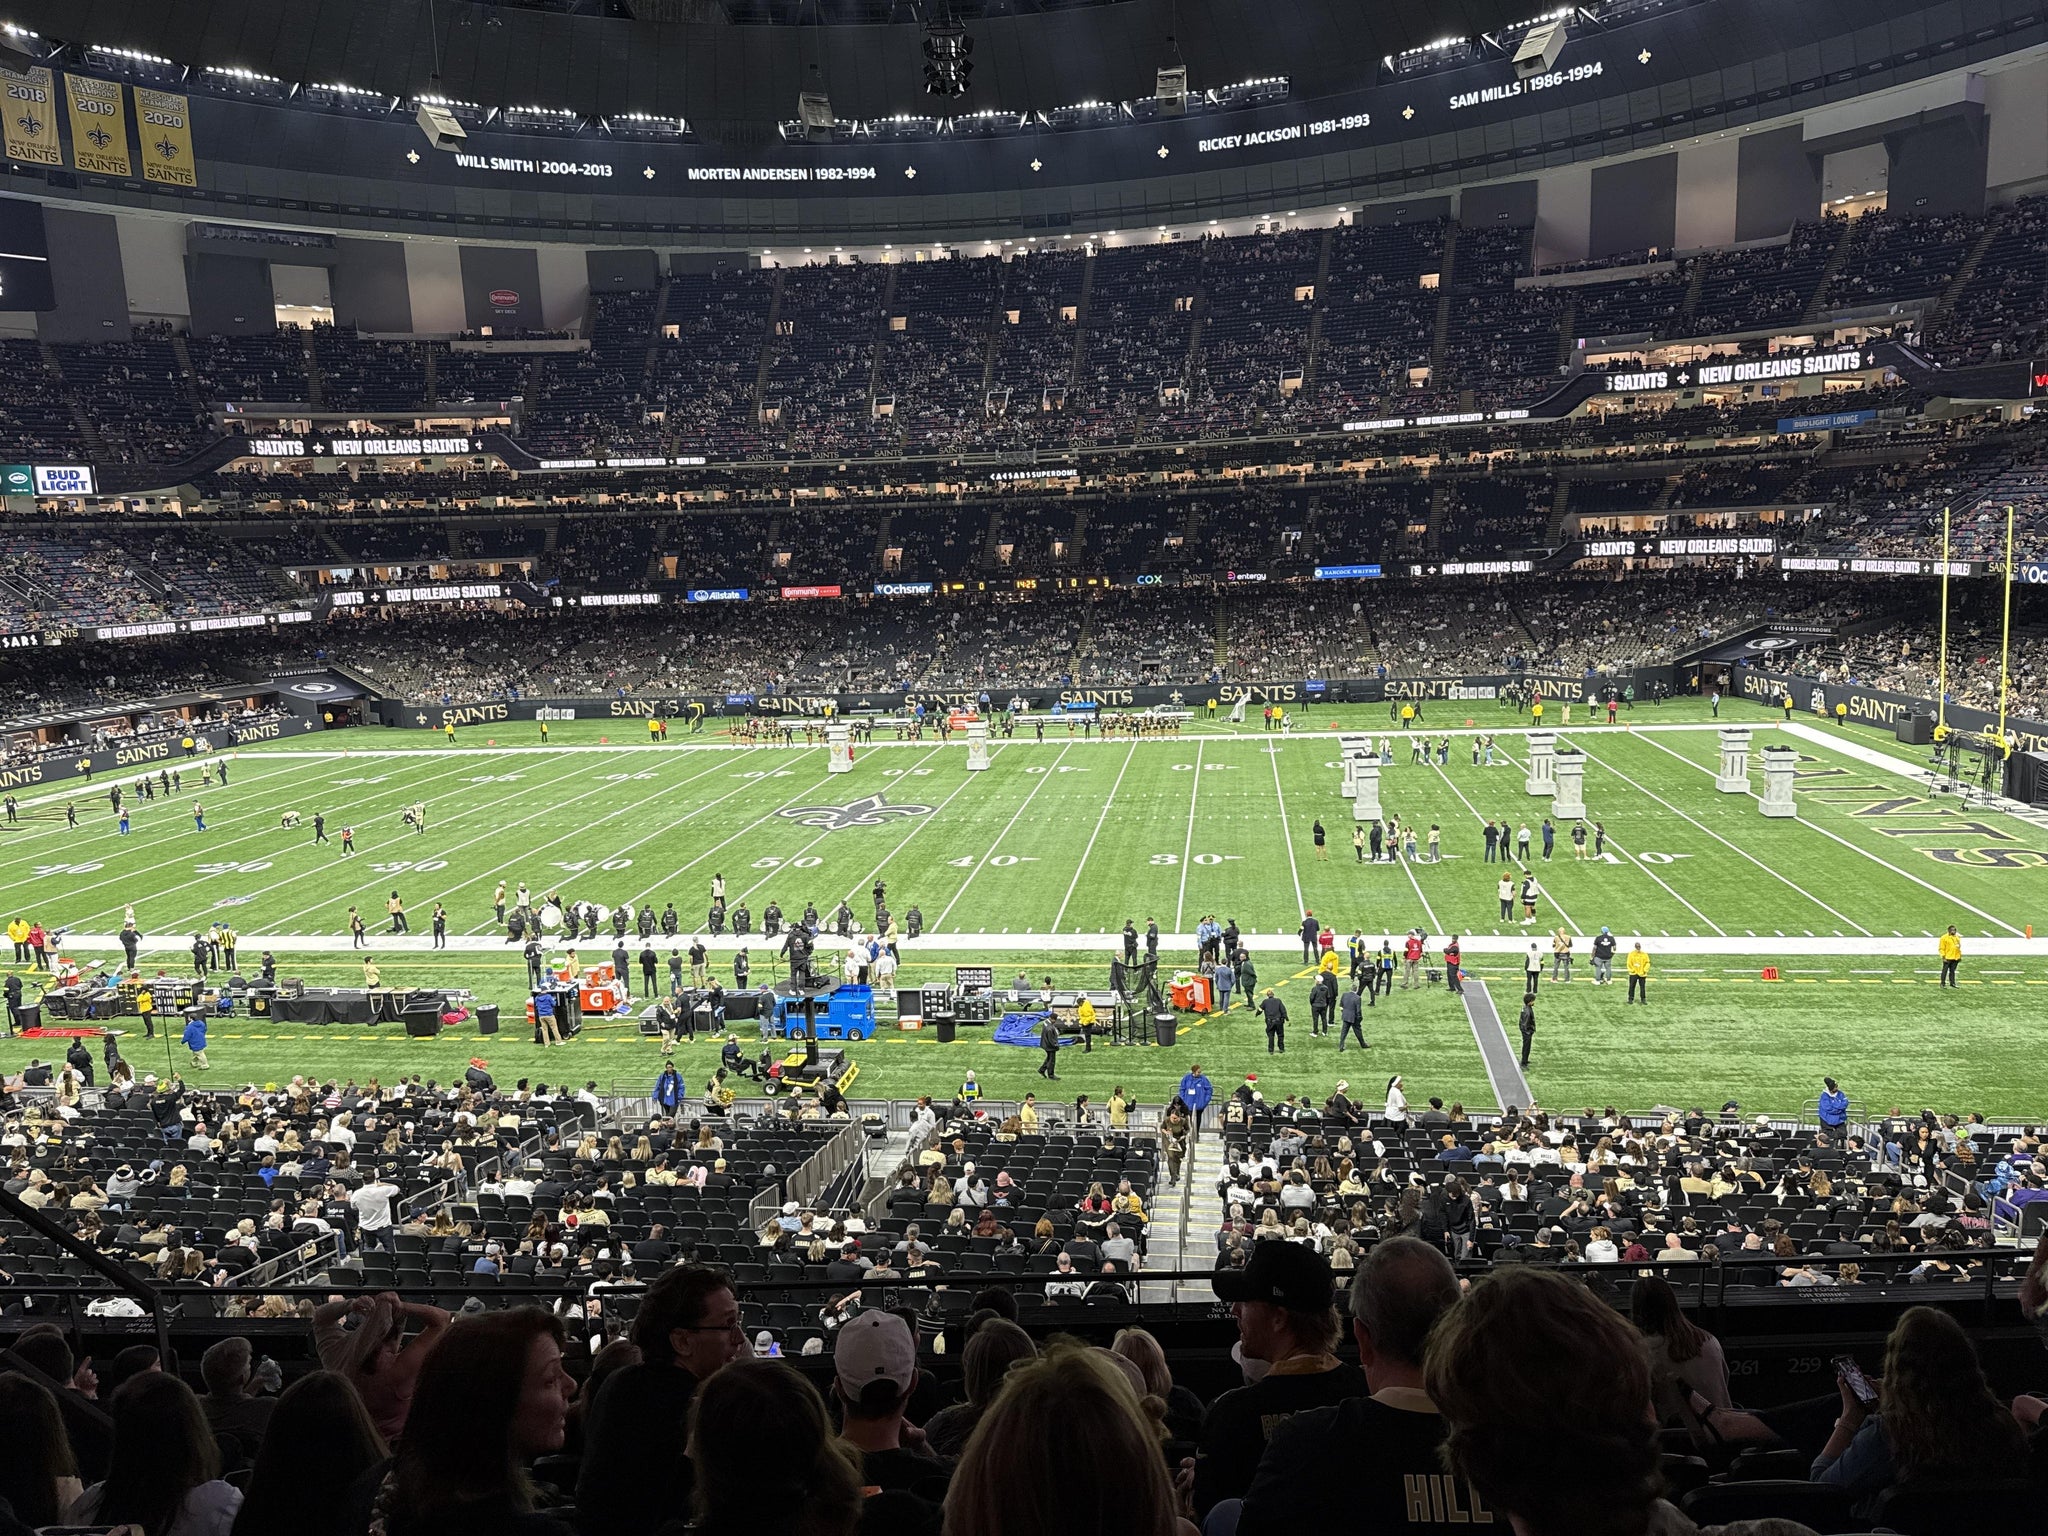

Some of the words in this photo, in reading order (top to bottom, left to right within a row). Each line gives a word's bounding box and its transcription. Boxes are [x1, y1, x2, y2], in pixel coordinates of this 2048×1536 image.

[7, 84, 47, 103] 2018
[1449, 90, 1480, 110] SAM
[1481, 81, 1522, 103] MILLS
[76, 98, 116, 117] 2019
[139, 97, 185, 113] CHAMPIONS
[144, 110, 184, 129] 2020
[1198, 135, 1242, 153] RICKEY
[1243, 126, 1301, 147] JACKSON
[9, 146, 59, 163] SAINTS
[78, 158, 127, 174] SAINTS
[455, 154, 489, 169] WILL
[490, 158, 534, 172] SMITH
[146, 169, 193, 185] SAINTS
[688, 168, 741, 181] MORTEN
[742, 168, 808, 181] ANDERSEN
[1699, 364, 1733, 385] NEW
[1735, 358, 1801, 381] ORLEANS
[1804, 352, 1861, 374] SAINTS
[1614, 371, 1668, 390] SAINTS
[1808, 418, 1830, 428] LIGHT
[1832, 414, 1859, 424] LOUNGE
[1267, 427, 1298, 435] SAINTS
[1633, 430, 1666, 440] SAINTS
[1706, 424, 1740, 434] SAINTS
[1134, 436, 1163, 444] SAINTS
[1199, 431, 1230, 440] SAINTS
[1561, 436, 1594, 445] SAINTS
[256, 440, 304, 456] SAINTS
[332, 439, 362, 455] NEW
[364, 438, 421, 454] ORLEANS
[423, 438, 469, 453] SAINTS
[938, 446, 968, 454] SAINTS
[1068, 440, 1098, 448] SAINTS
[1490, 441, 1522, 450] SAINTS
[810, 452, 840, 460] SAINTS
[874, 449, 904, 458] SAINTS
[1352, 450, 1383, 459] SAINTS
[1420, 446, 1452, 455] SAINTS
[746, 454, 774, 462] SAINTS
[1223, 459, 1252, 467] SAINTS
[1287, 455, 1316, 463] SAINTS
[1101, 466, 1129, 474] SAINTS
[1162, 462, 1190, 471] SAINTS
[46, 470, 81, 481] BUD
[1032, 470, 1078, 478] SUPERDOME
[41, 481, 88, 492] LIGHT
[516, 488, 546, 496] SAINTS
[580, 486, 609, 494] SAINTS
[641, 485, 670, 493] SAINTS
[702, 483, 731, 491] SAINTS
[252, 492, 282, 500] SAINTS
[318, 492, 348, 500] SAINTS
[451, 490, 482, 498] SAINTS
[1591, 541, 1636, 556] SAINTS
[1660, 540, 1686, 554] NEW
[1688, 538, 1738, 554] ORLEANS
[1739, 538, 1773, 553] SAINTS
[1442, 562, 1465, 575] NEW
[1466, 562, 1511, 574] ORLEANS
[1790, 559, 1814, 571] ORLEANS
[1814, 559, 1839, 571] SAINTS
[1851, 560, 1866, 572] NEW
[1866, 560, 1894, 574] ORLEANS
[1894, 561, 1920, 574] SAINTS
[1136, 574, 1162, 584] COX
[1183, 573, 1212, 581] SAINTS
[1236, 572, 1266, 581] entergy
[386, 588, 411, 603] NEW
[412, 586, 461, 602] ORLEANS
[462, 584, 501, 599] SAINTS
[784, 587, 820, 597] Community
[884, 584, 932, 595] Ochsner
[580, 596, 602, 607] NEW
[602, 594, 641, 606] ORLEANS
[708, 591, 740, 601] Allstate
[190, 620, 206, 632] NEW
[206, 617, 239, 630] ORLEANS
[240, 615, 266, 628] SAINTS
[279, 612, 293, 624] NEW
[43, 629, 79, 641] SAINTS
[112, 625, 147, 639] ORLEANS
[148, 623, 177, 636] SAINTS
[1798, 626, 1832, 634] SUPERDOME
[1220, 684, 1296, 702] SAINTS
[1523, 678, 1583, 698] SAINTS
[1060, 688, 1134, 706] SAINTS
[4, 700, 157, 729] SUPERDOME
[442, 702, 508, 726] SAINTS
[235, 723, 280, 743] SAINTS
[116, 742, 170, 766] SAINTS
[558, 858, 634, 871] 40
[750, 856, 824, 868] 50
[947, 855, 1020, 867] 40
[1148, 853, 1223, 866] 30
[1601, 852, 1674, 865] 10
[194, 862, 274, 875] 20
[371, 860, 449, 873] 30
[1766, 968, 1777, 980] 10
[589, 992, 604, 1008] G
[1227, 1106, 1244, 1123] 23
[1730, 1361, 1760, 1376] 261
[1787, 1357, 1823, 1373] 259
[1403, 1473, 1494, 1525] HILL
